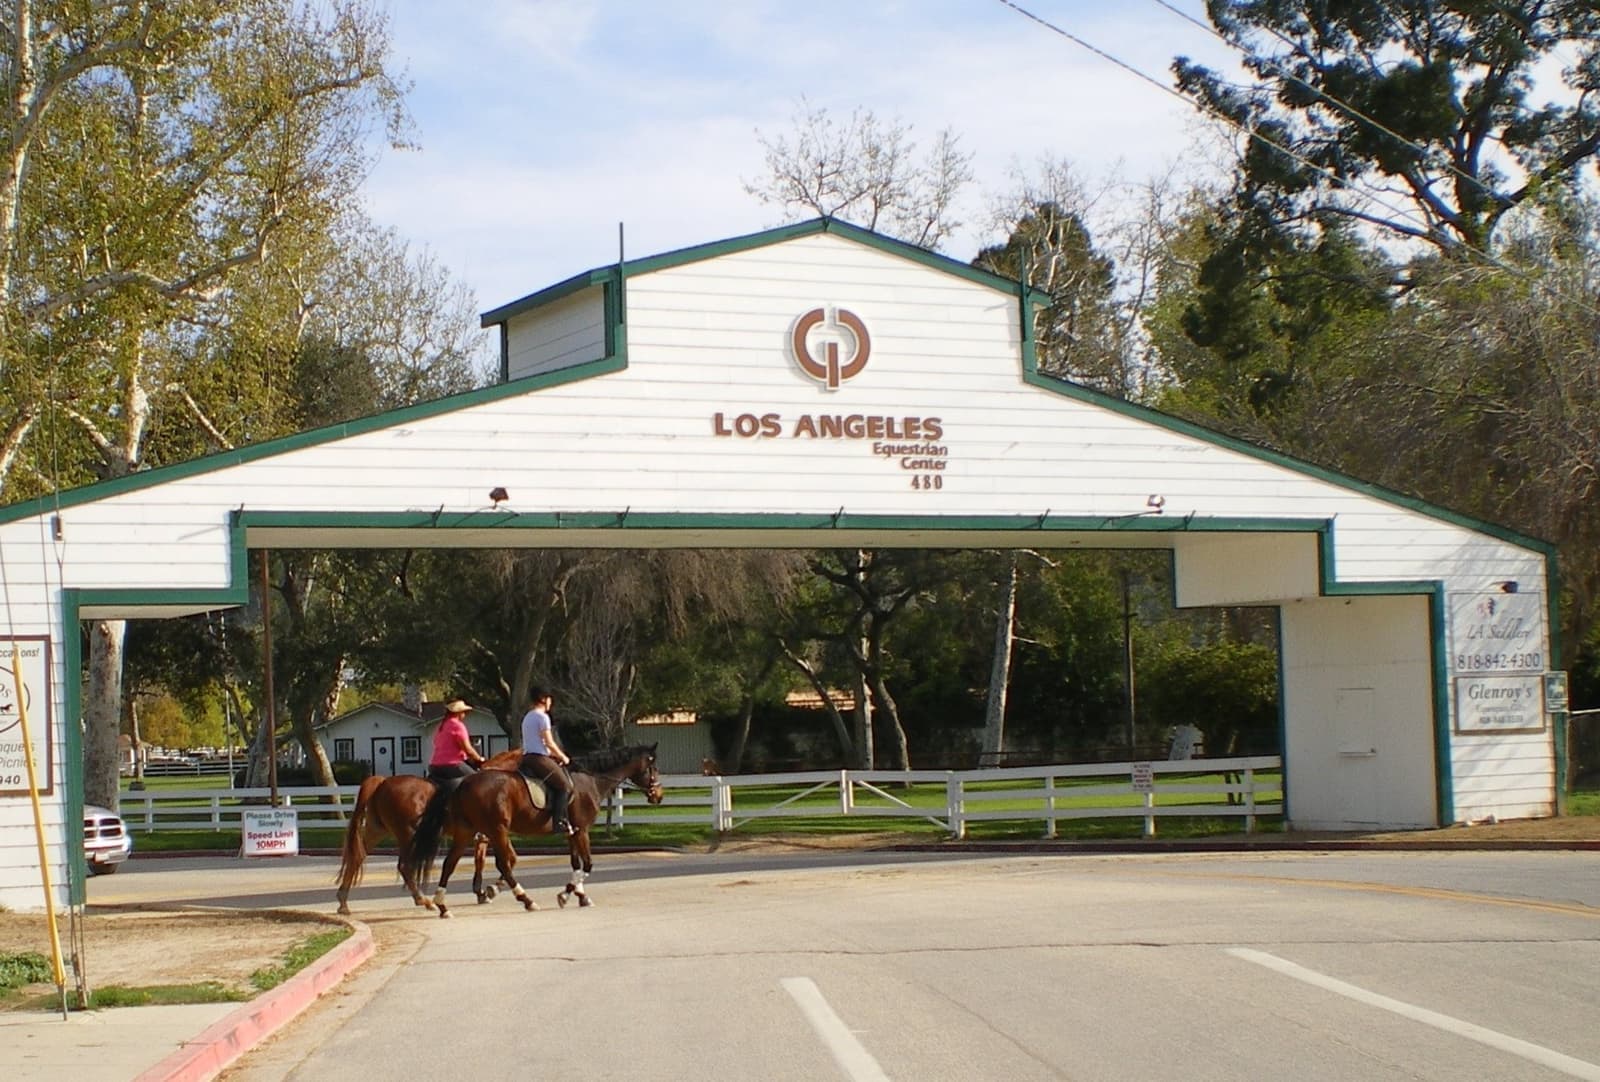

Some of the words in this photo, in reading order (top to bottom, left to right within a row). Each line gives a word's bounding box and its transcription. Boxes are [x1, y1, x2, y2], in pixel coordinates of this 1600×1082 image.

[713, 412, 782, 438] LOS
[793, 414, 944, 441] ANGELES
[872, 441, 949, 458] Equestrian
[901, 456, 948, 471] Center
[911, 474, 943, 490] 480
[0, 648, 40, 658] caons!
[1457, 652, 1541, 670] 818-842-4300
[1468, 683, 1533, 702] Glenroy's
[247, 831, 273, 840] Speed
[275, 830, 294, 838] Limit
[256, 840, 286, 849] 10MPH
